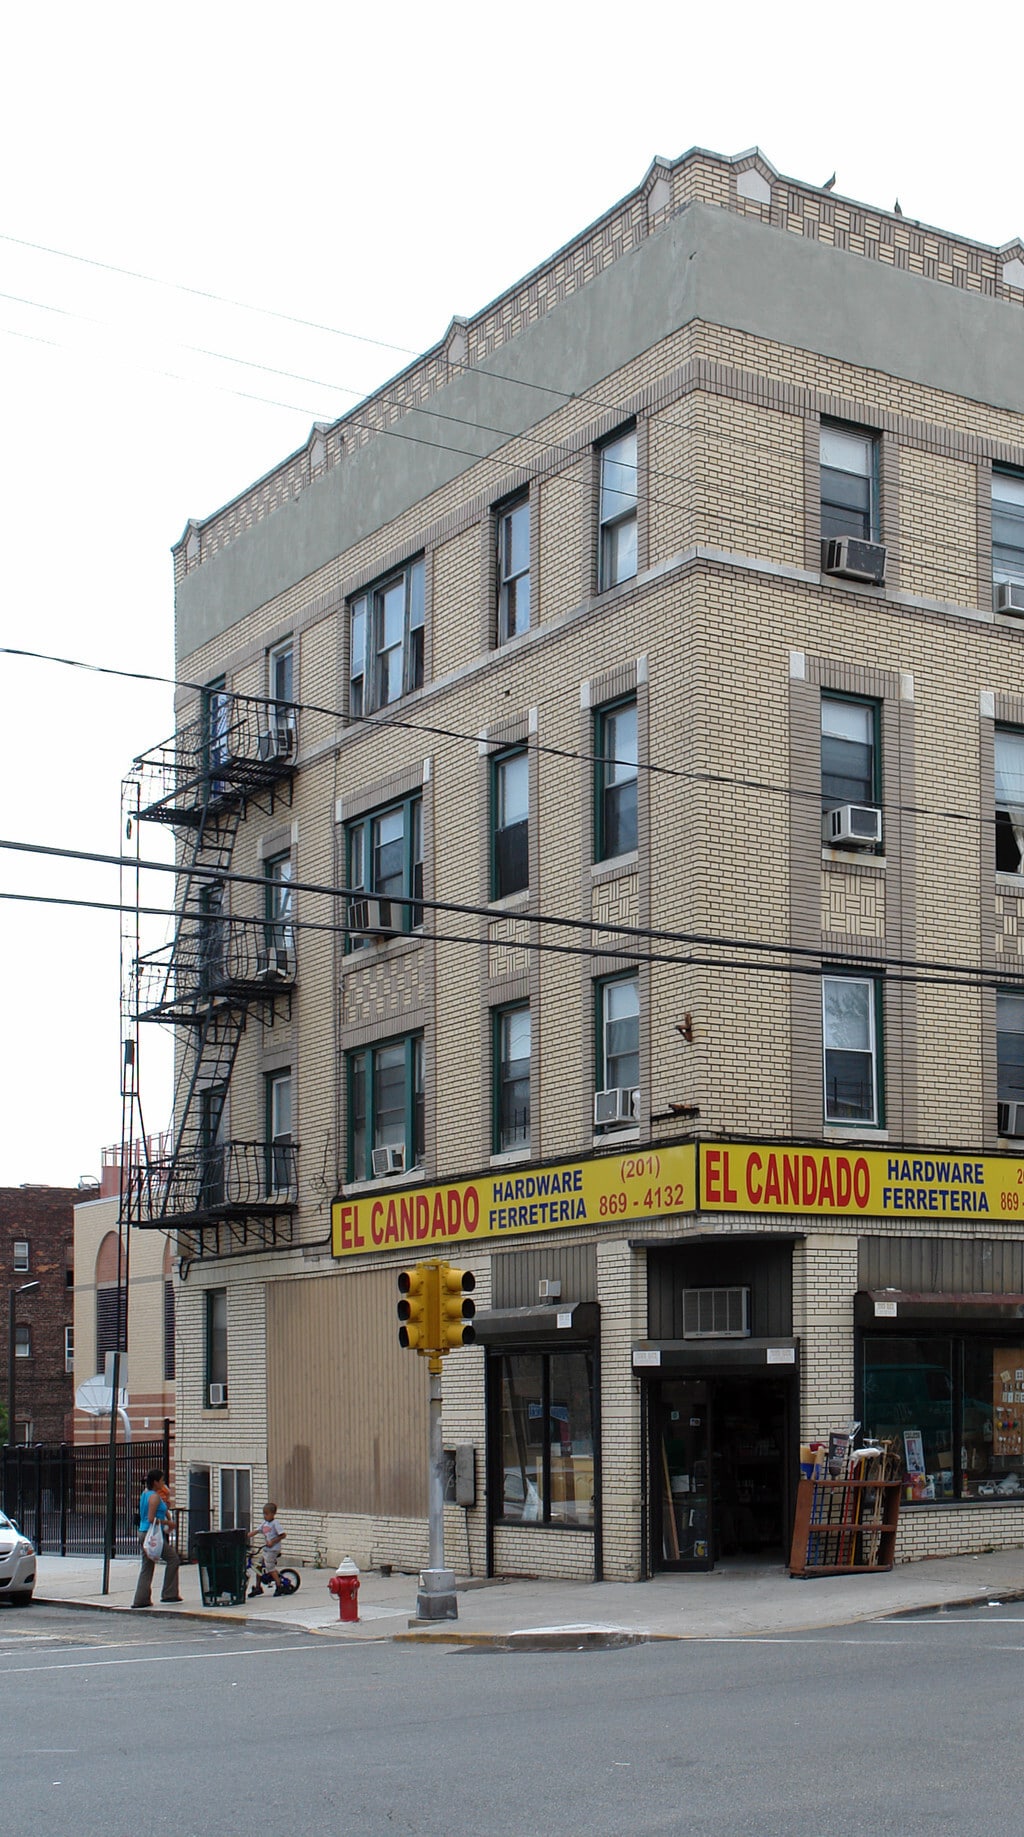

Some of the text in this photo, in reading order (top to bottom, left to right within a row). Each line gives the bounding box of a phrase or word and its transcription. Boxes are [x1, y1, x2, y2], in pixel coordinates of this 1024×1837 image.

[620, 1154, 661, 1183] (201)
[705, 1150, 871, 1209] EL CANDADO
[887, 1159, 985, 1185] HARDWARE
[493, 1169, 583, 1203] HARDWARE
[599, 1192, 627, 1216] 869
[643, 1183, 684, 1209] 4132
[882, 1187, 990, 1213] FERRETERIA
[1000, 1192, 1019, 1211] 869
[341, 1185, 480, 1249] EL CANDADO
[489, 1198, 588, 1231] FERRETERIA
